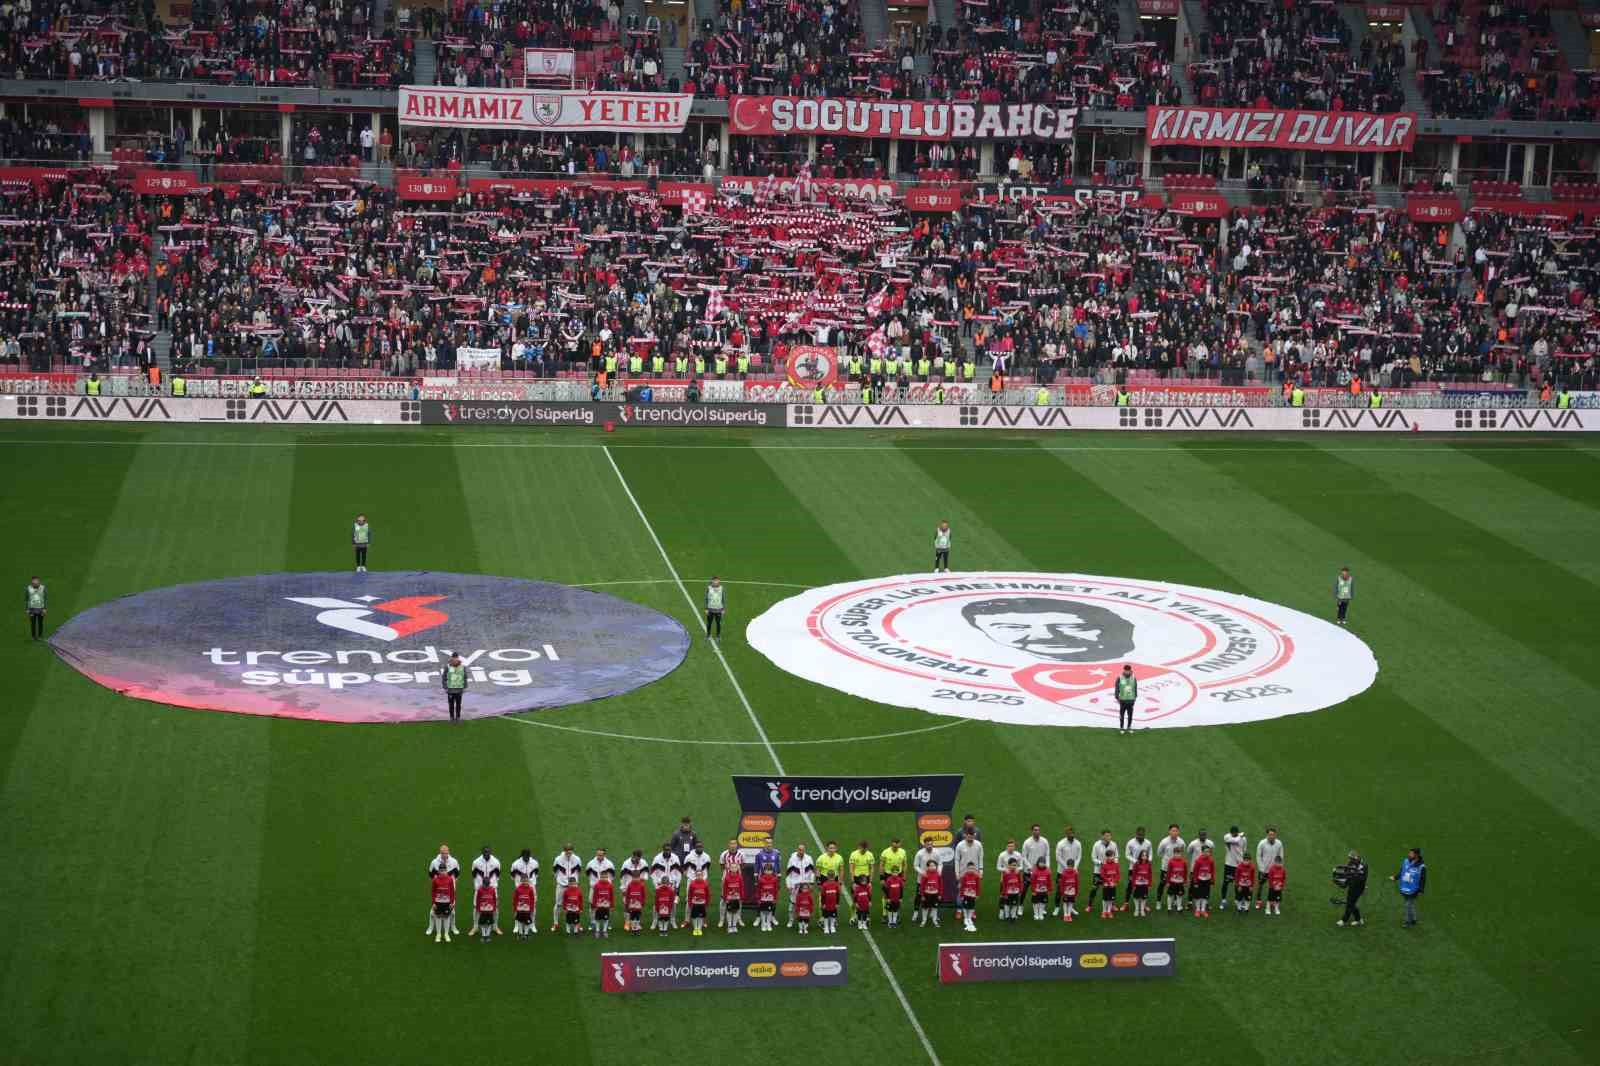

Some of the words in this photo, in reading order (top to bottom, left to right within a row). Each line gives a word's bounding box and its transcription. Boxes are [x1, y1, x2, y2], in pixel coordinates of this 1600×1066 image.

[405, 94, 523, 121] ARMAMIZ
[578, 99, 680, 123] YETER!
[1151, 109, 1285, 143] KIRMIZI
[1289, 114, 1411, 147] DUVAR
[459, 405, 533, 422] trendyol
[634, 405, 708, 422] trendyol
[202, 644, 560, 667] trendyol
[931, 689, 1025, 706] 2025
[1209, 685, 1294, 702] 2026
[792, 786, 869, 803] trendyol
[972, 956, 1027, 969] trendyol
[635, 965, 693, 979] trendyol
